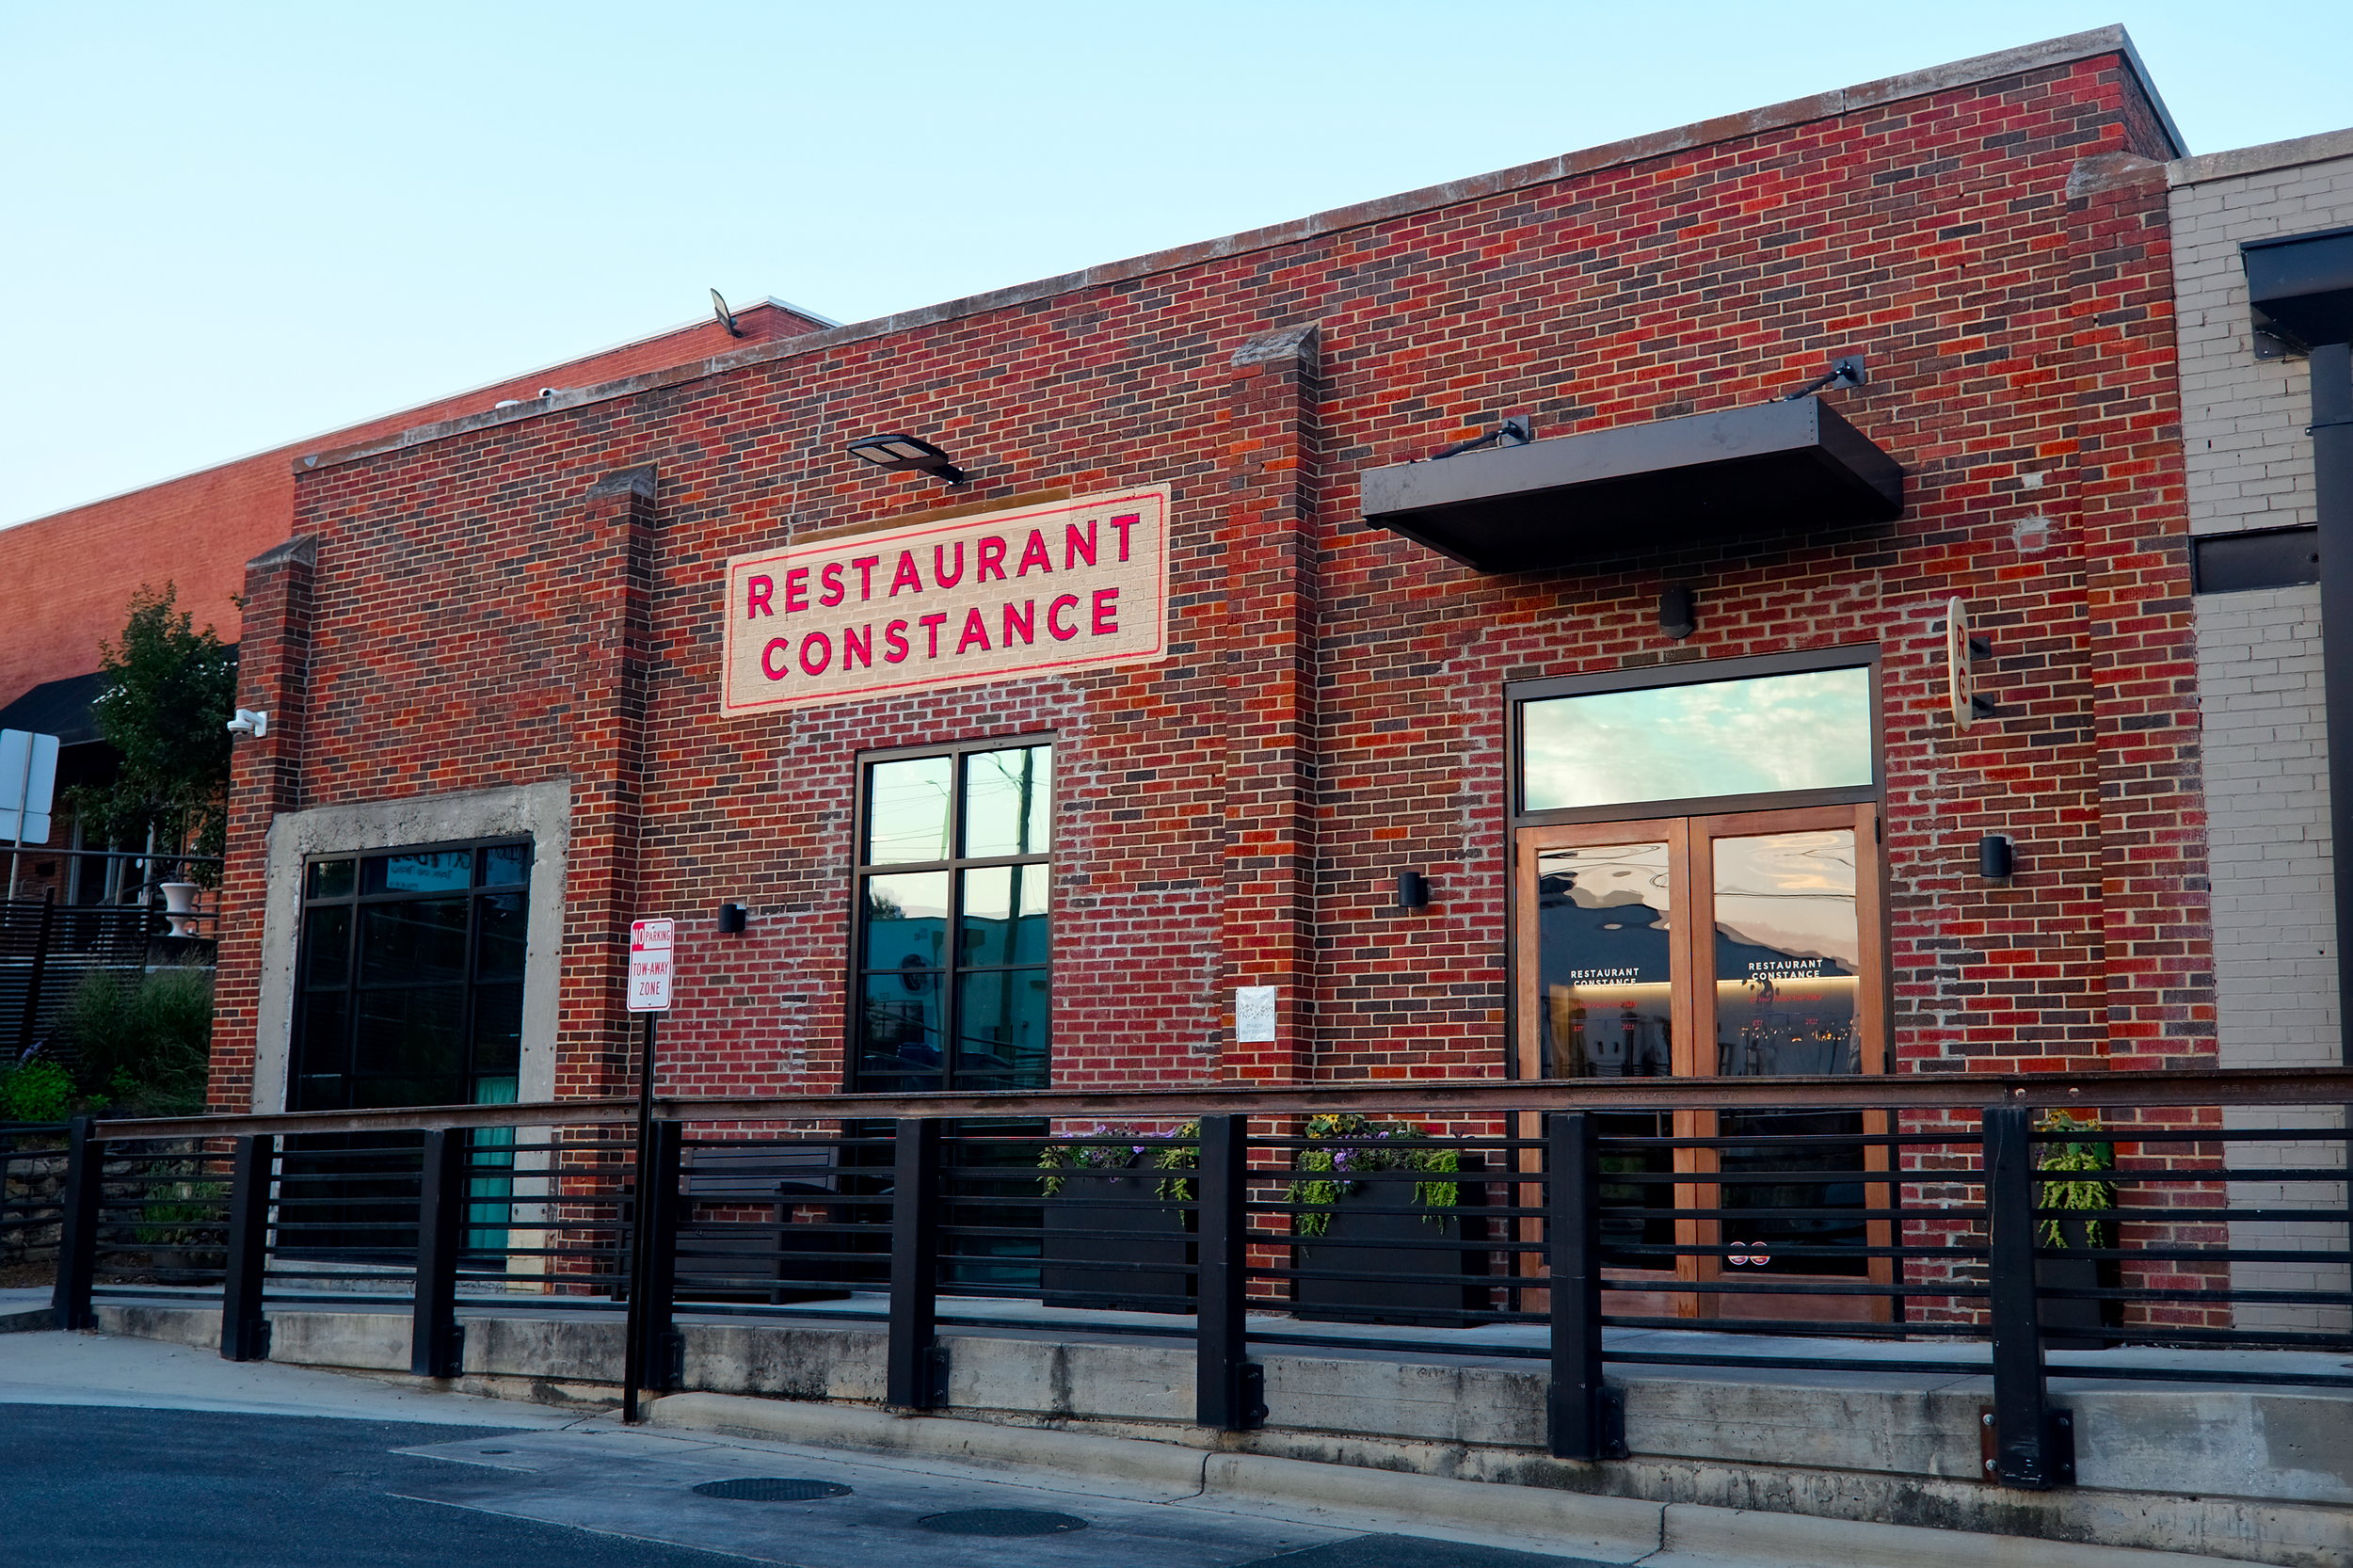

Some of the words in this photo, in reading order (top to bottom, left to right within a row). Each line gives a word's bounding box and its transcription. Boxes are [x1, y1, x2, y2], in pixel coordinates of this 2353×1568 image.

[747, 513, 1141, 619] RESTAURANT
[760, 586, 1120, 680] CONSTANCE
[632, 928, 644, 945] NO
[645, 930, 670, 942] PARKING
[632, 961, 669, 976] TOW-AWAY
[1748, 959, 1823, 971] RESTAURANT
[1570, 968, 1640, 979] RESTAURANT
[1752, 969, 1820, 981] CONSTANCE
[639, 981, 661, 996] ZONE
[1610, 1091, 1678, 1100] MARYLAND
